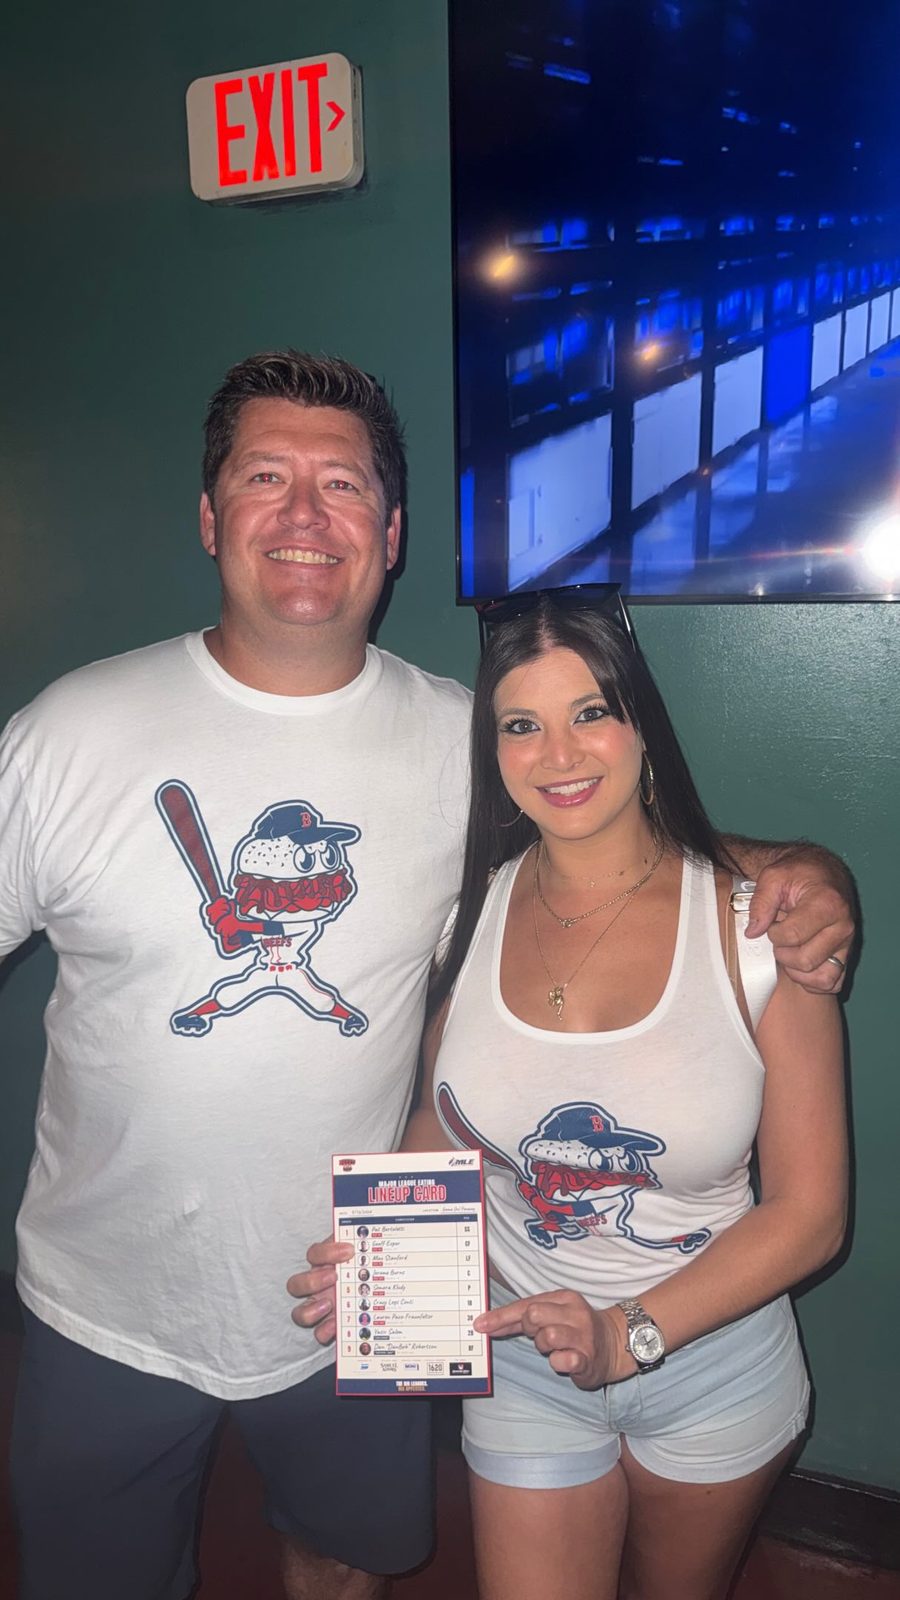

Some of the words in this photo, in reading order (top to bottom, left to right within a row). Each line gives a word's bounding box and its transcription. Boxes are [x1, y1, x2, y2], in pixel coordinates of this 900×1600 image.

[214, 62, 328, 187] EXIT
[300, 811, 312, 828] B
[262, 936, 292, 948] BEEFS
[589, 1115, 604, 1132] B
[398, 1179, 416, 1187] LEAGUE
[368, 1186, 410, 1204] LINEUP
[414, 1184, 447, 1202] CARD
[428, 1364, 442, 1372] 1620
